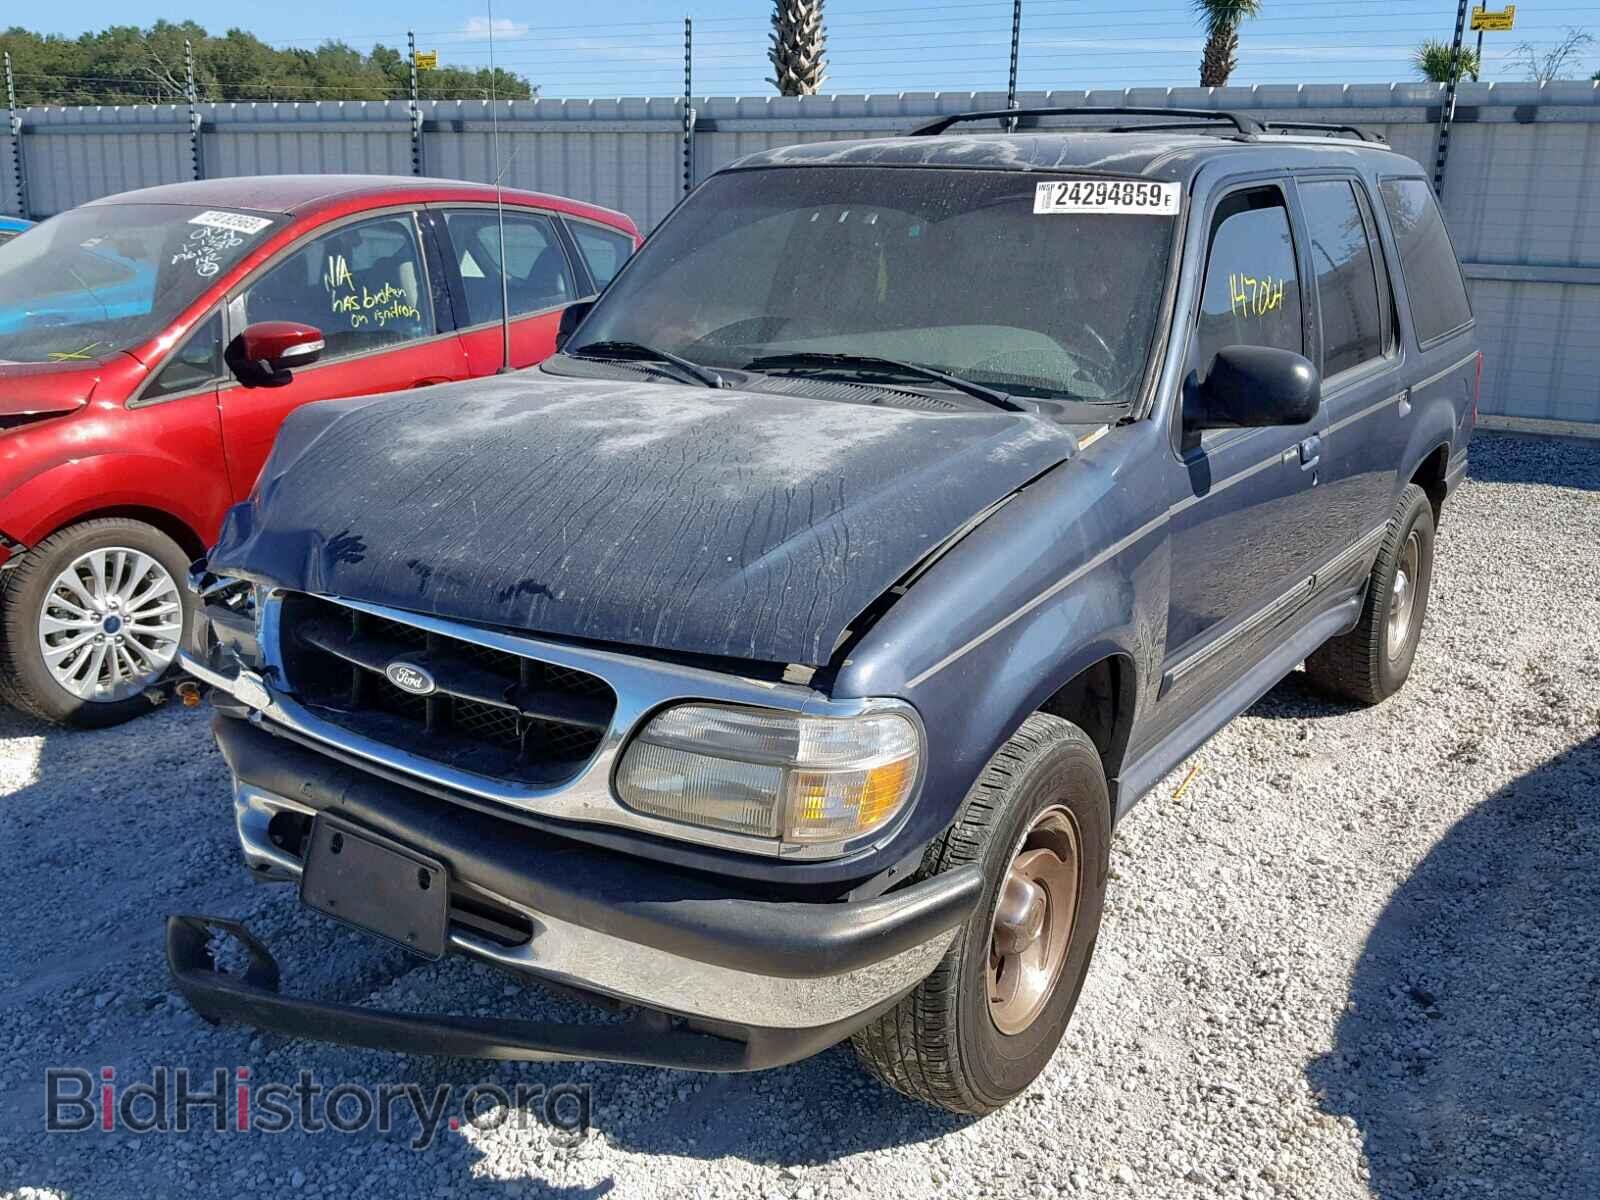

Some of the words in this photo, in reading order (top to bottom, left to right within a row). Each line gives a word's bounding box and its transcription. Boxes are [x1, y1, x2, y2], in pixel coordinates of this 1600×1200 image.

[1055, 182, 1162, 207] 24294859
[351, 313, 369, 328] on
[396, 667, 423, 689] Ford
